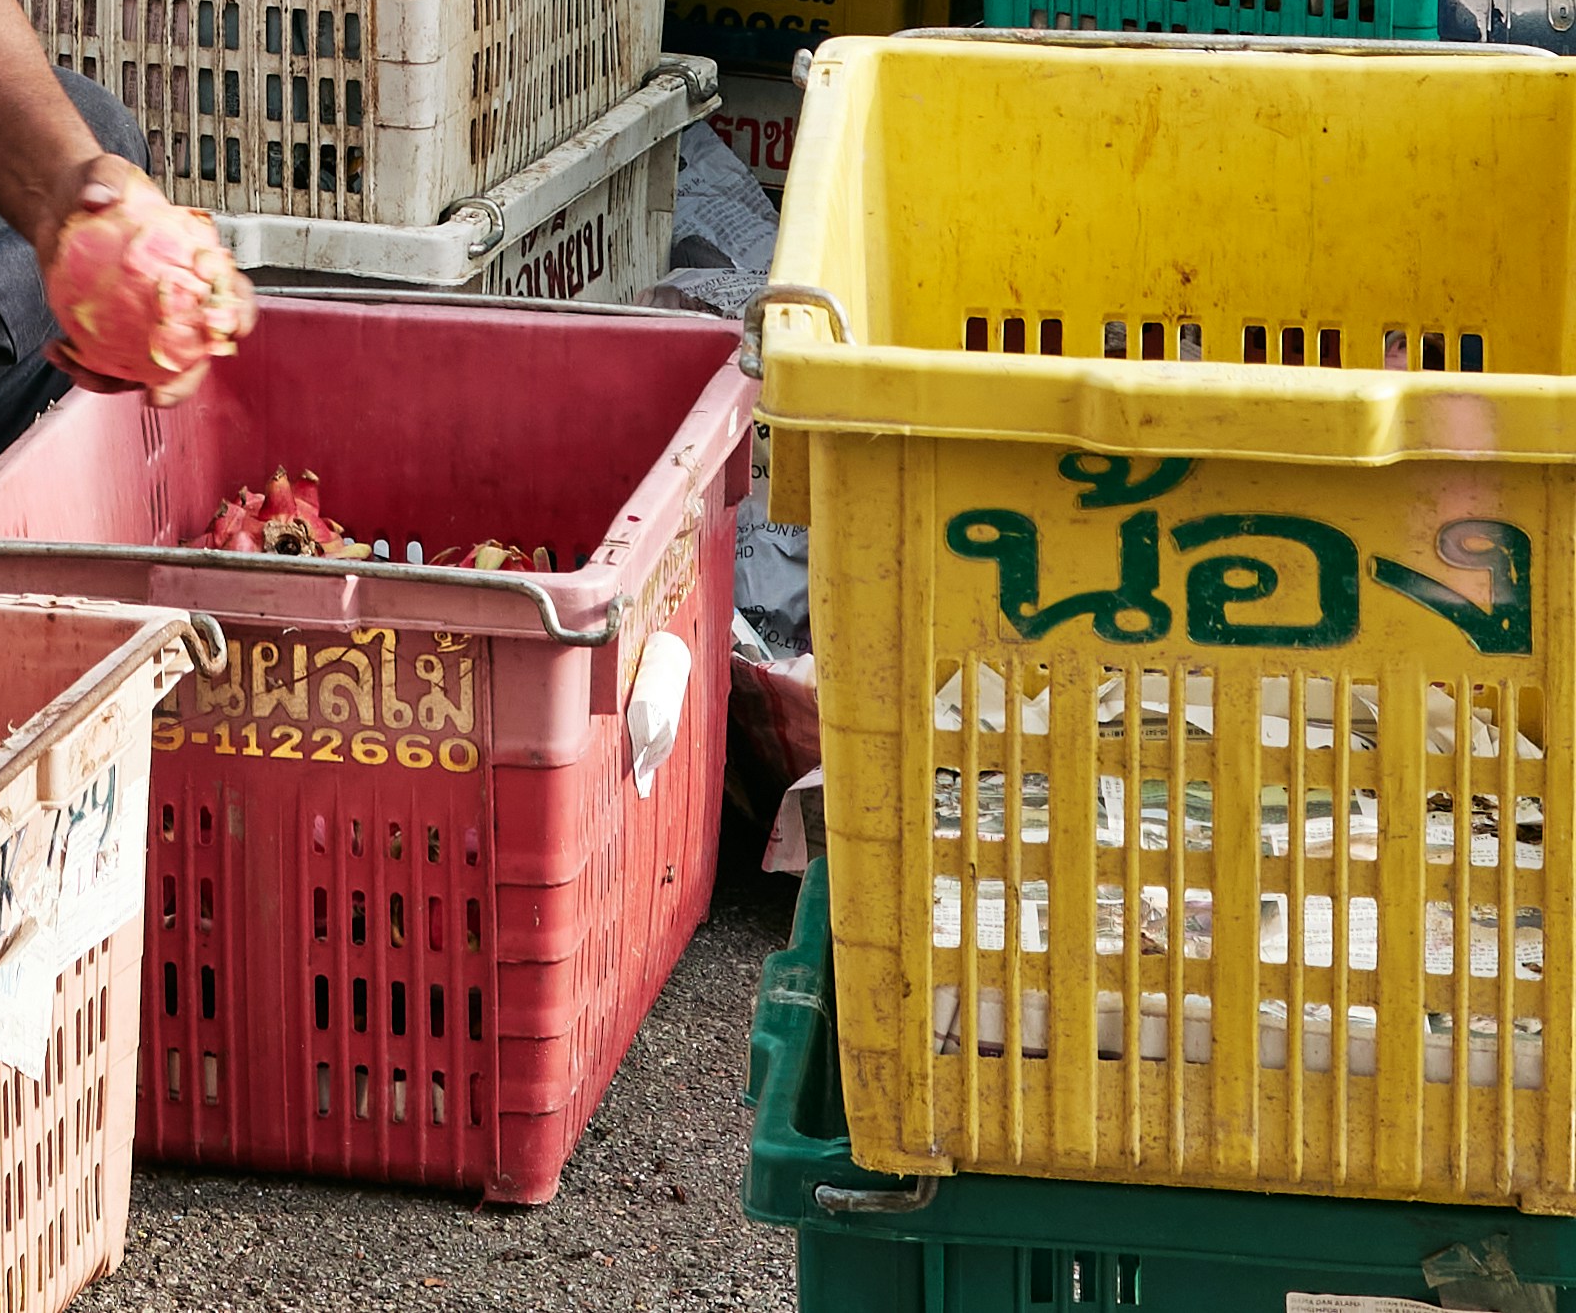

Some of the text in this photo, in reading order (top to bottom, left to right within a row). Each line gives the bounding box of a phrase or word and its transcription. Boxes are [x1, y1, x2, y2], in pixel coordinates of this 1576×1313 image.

[945, 451, 1534, 657] น้อง
[161, 628, 475, 734] นผลไม้
